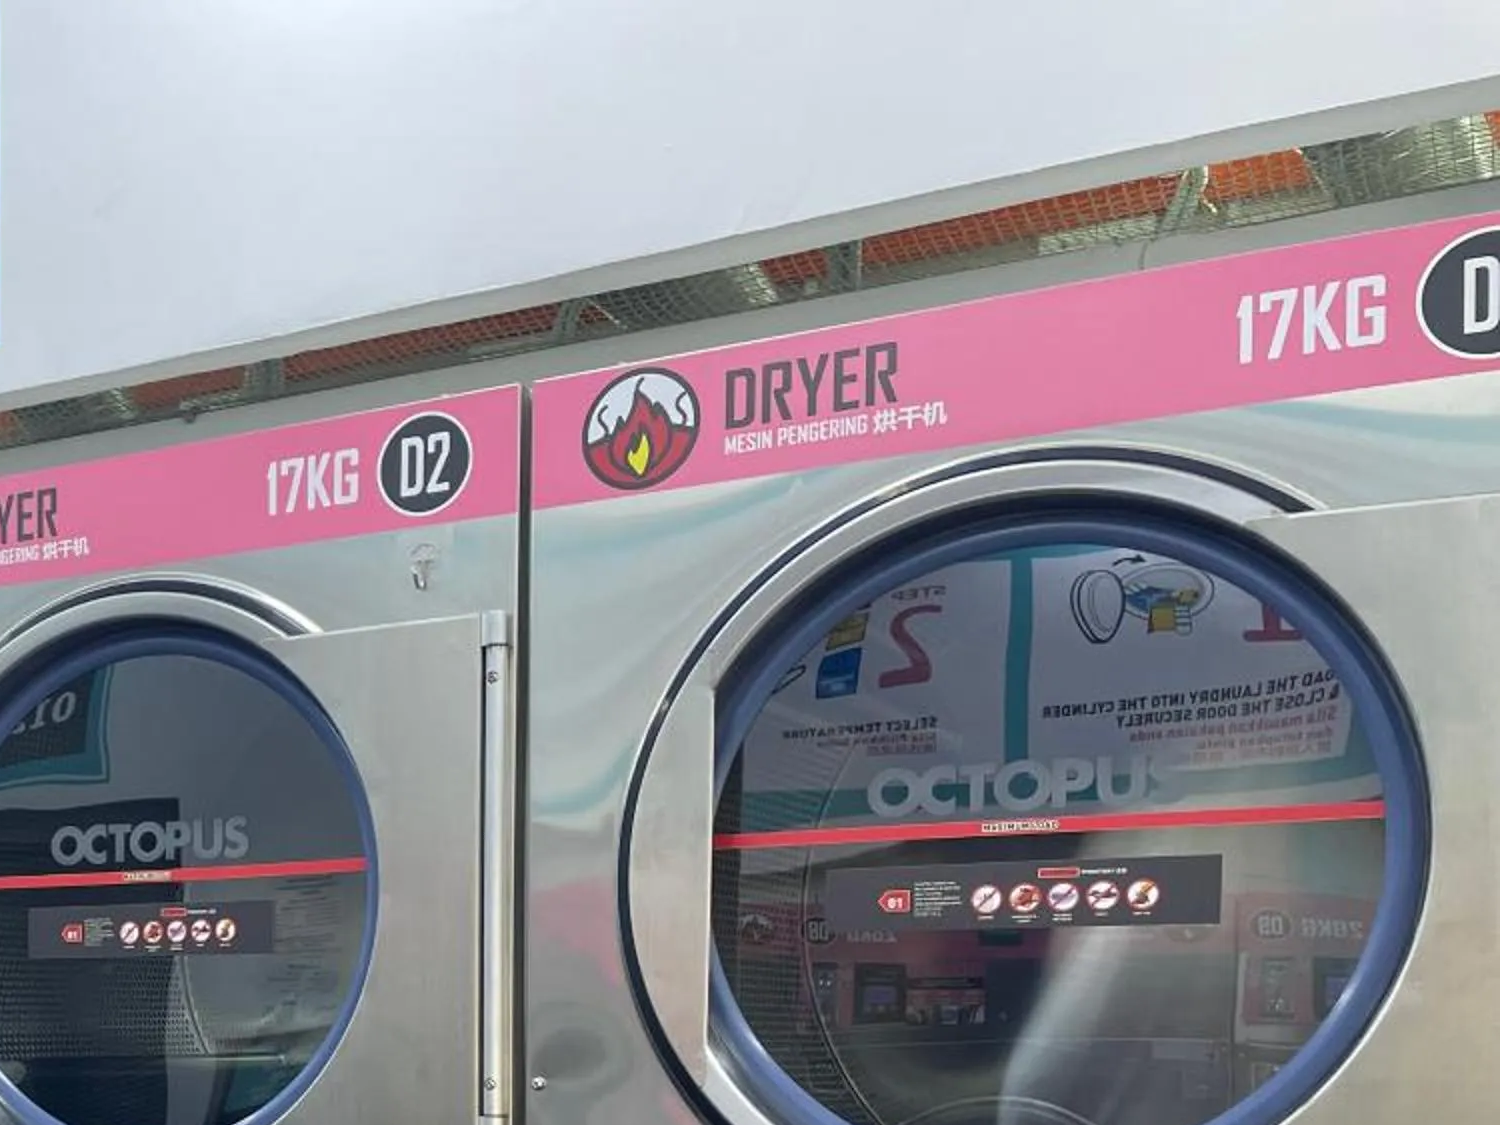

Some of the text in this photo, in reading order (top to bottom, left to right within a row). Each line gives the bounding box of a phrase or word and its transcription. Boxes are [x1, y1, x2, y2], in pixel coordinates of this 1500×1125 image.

[1236, 273, 1387, 365] 17KG
[725, 341, 899, 430] DRYER
[873, 400, 948, 436] 烘干机
[724, 414, 869, 455] MESIN PENGERING
[266, 432, 451, 516] 17KG D2
[867, 753, 1166, 820] OCTOPU
[51, 816, 250, 867] OCTOPUS
